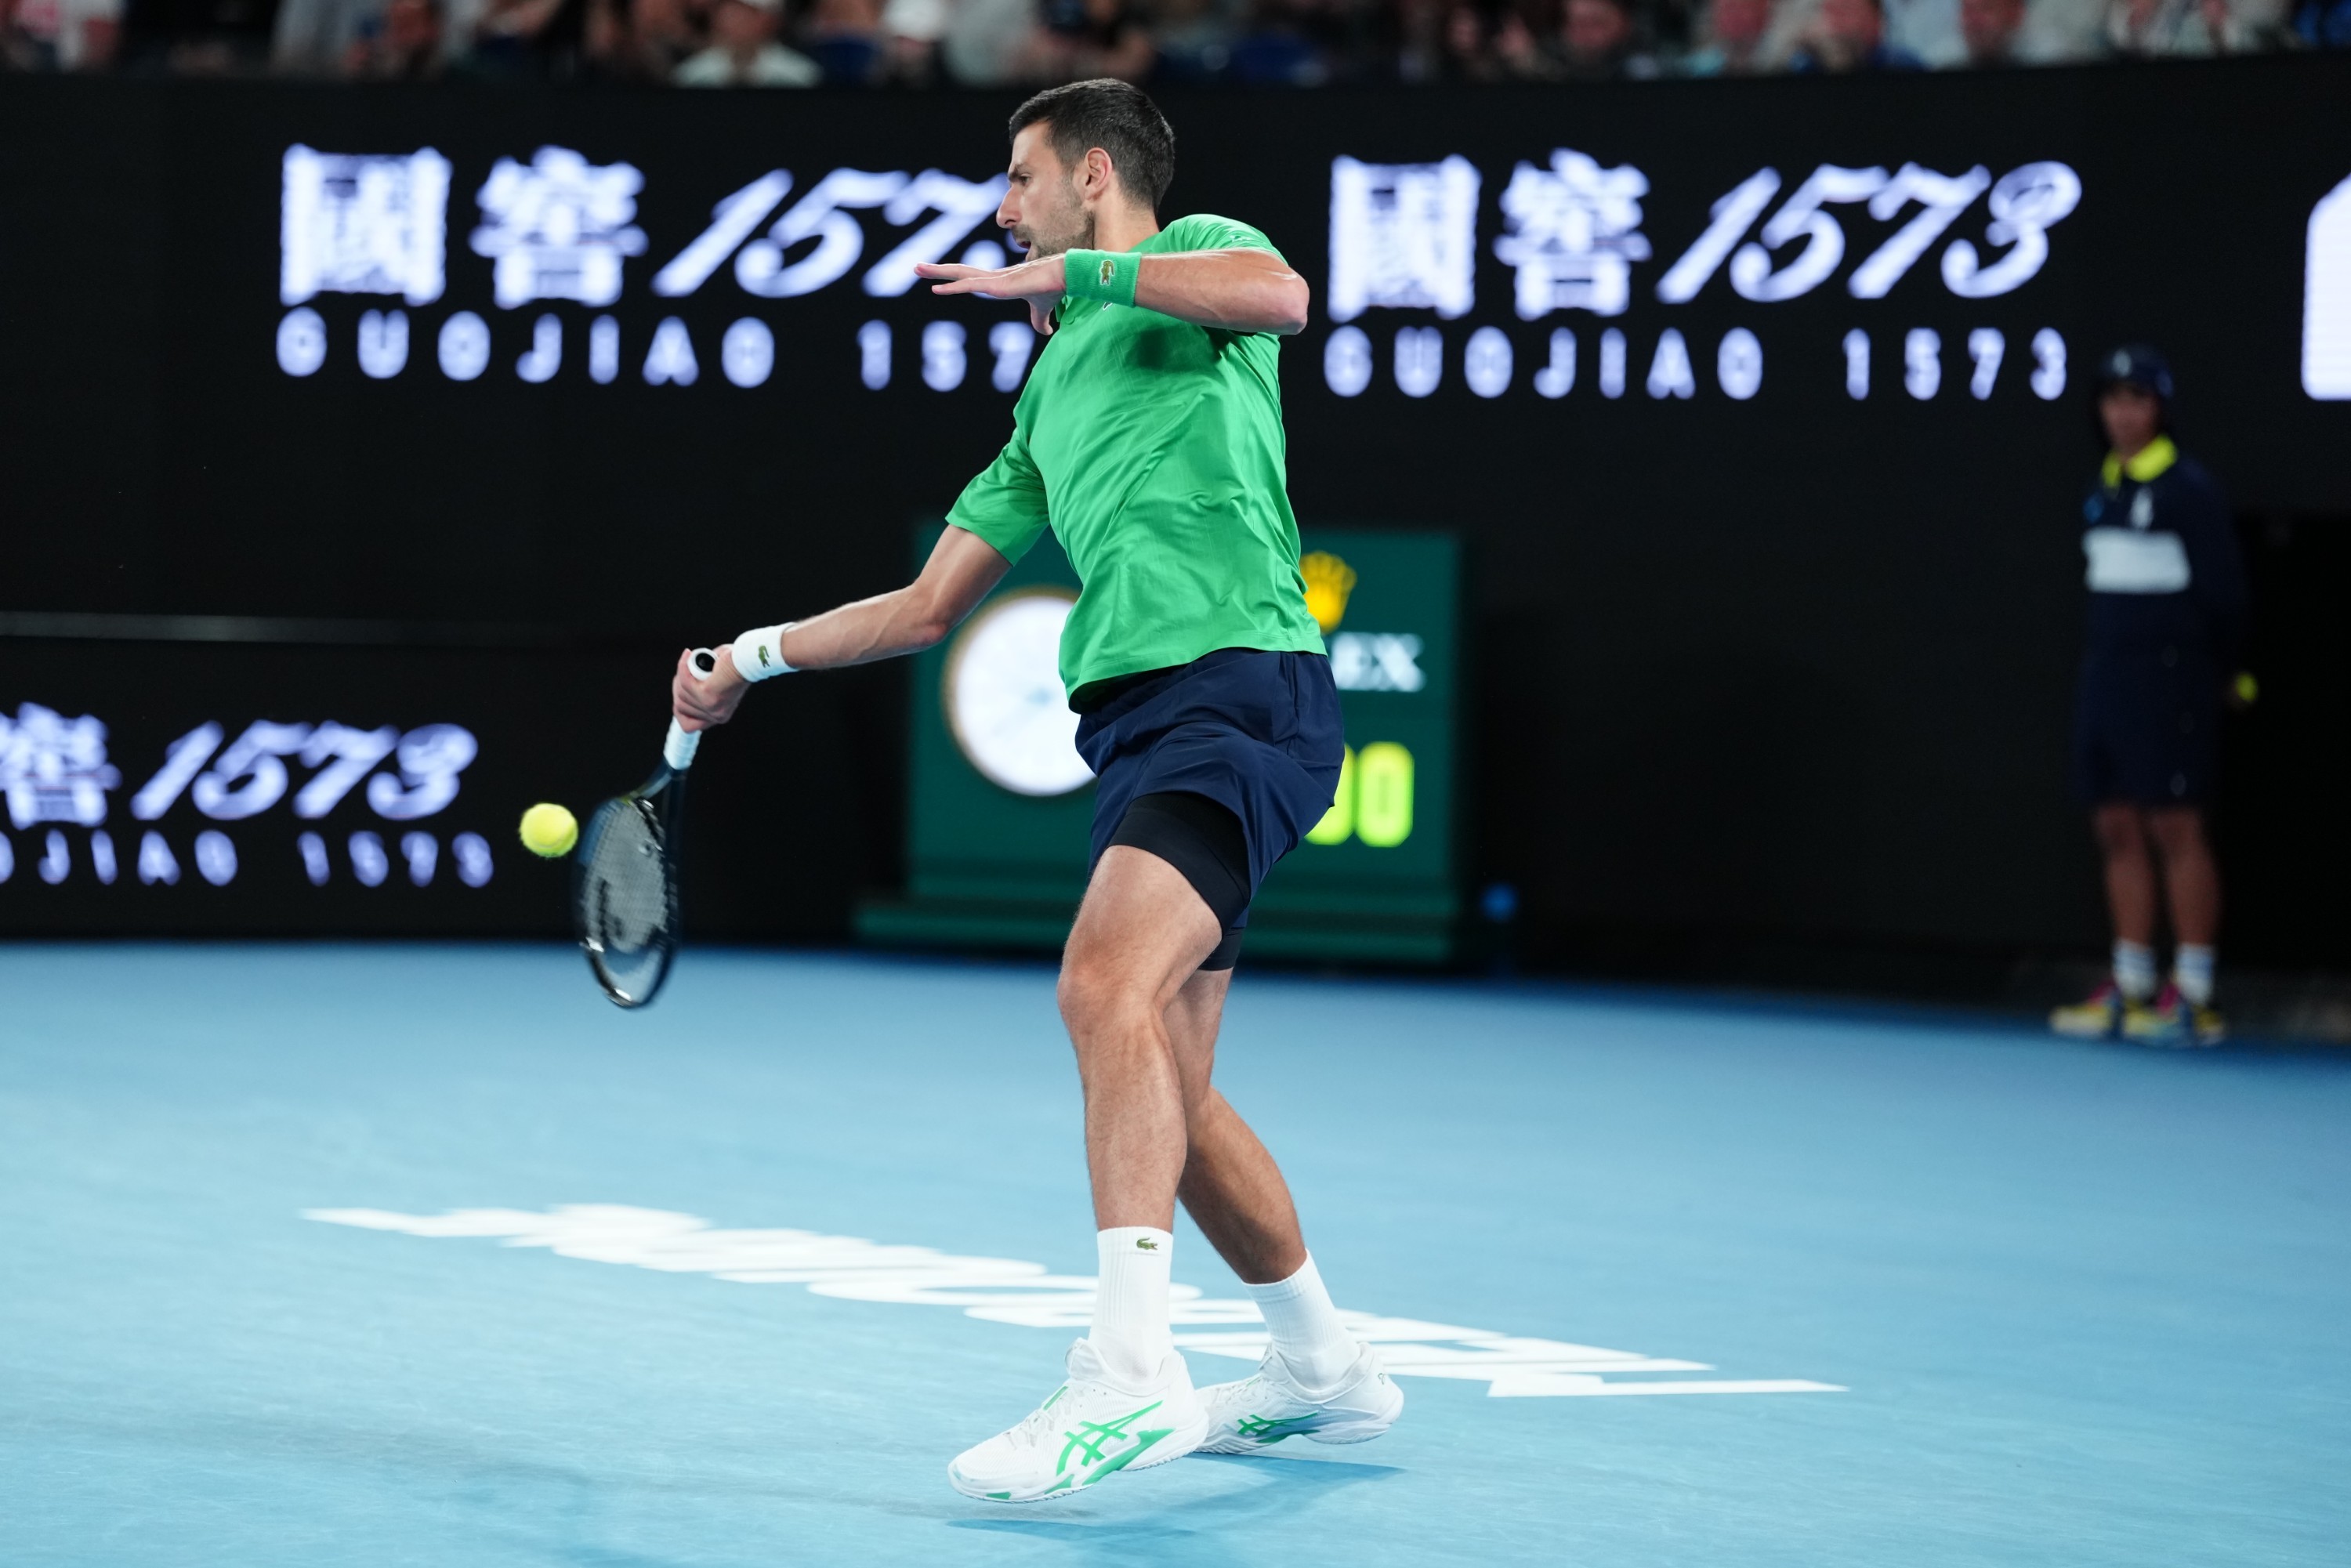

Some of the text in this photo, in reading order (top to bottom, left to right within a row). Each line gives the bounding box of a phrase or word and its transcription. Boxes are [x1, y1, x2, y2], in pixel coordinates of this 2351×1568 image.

[276, 308, 1035, 393] GUOJIAO 157
[1324, 325, 2067, 401] GUOJIAO 1573
